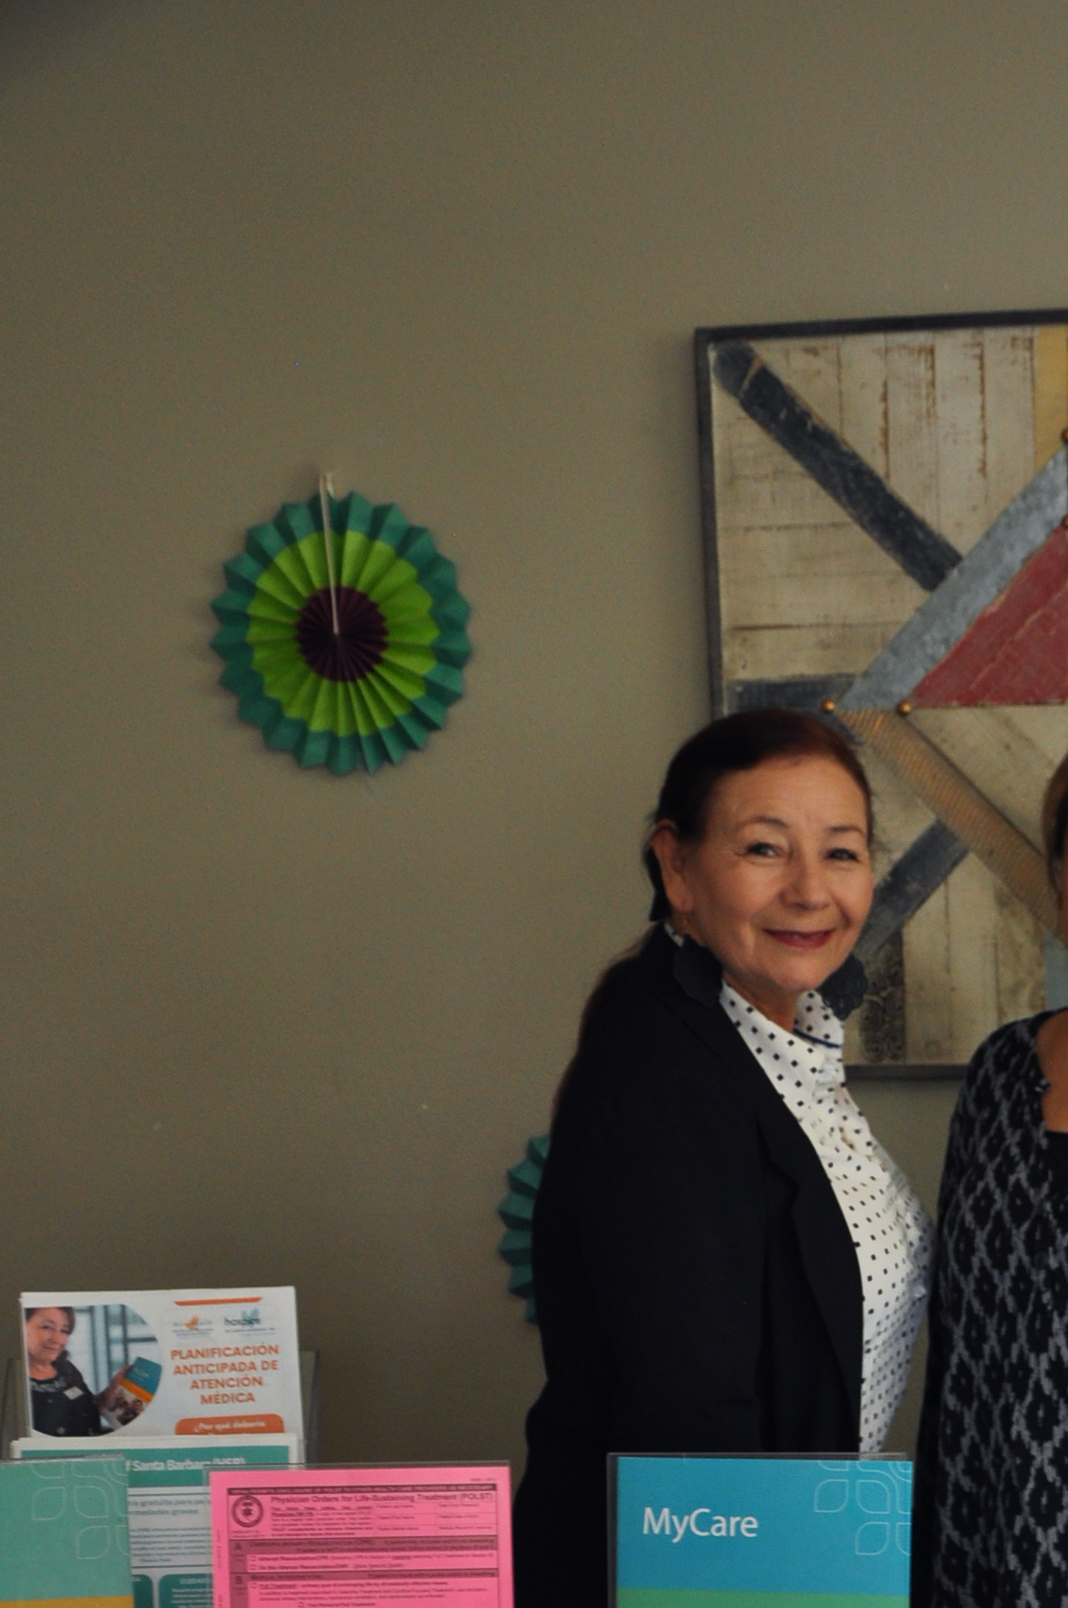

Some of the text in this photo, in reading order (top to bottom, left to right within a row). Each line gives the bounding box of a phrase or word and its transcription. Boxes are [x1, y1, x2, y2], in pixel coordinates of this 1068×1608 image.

[170, 1342, 280, 1360] PLANIFICACIÓN
[173, 1360, 279, 1375] ANTICIPADA DE
[190, 1374, 263, 1389] ATENCIÓN
[200, 1391, 255, 1404] MÉDICA
[133, 1460, 165, 1471] Santa
[270, 1496, 310, 1504] Physician
[417, 1493, 457, 1501] Treatment
[643, 1507, 759, 1544] MyCare
